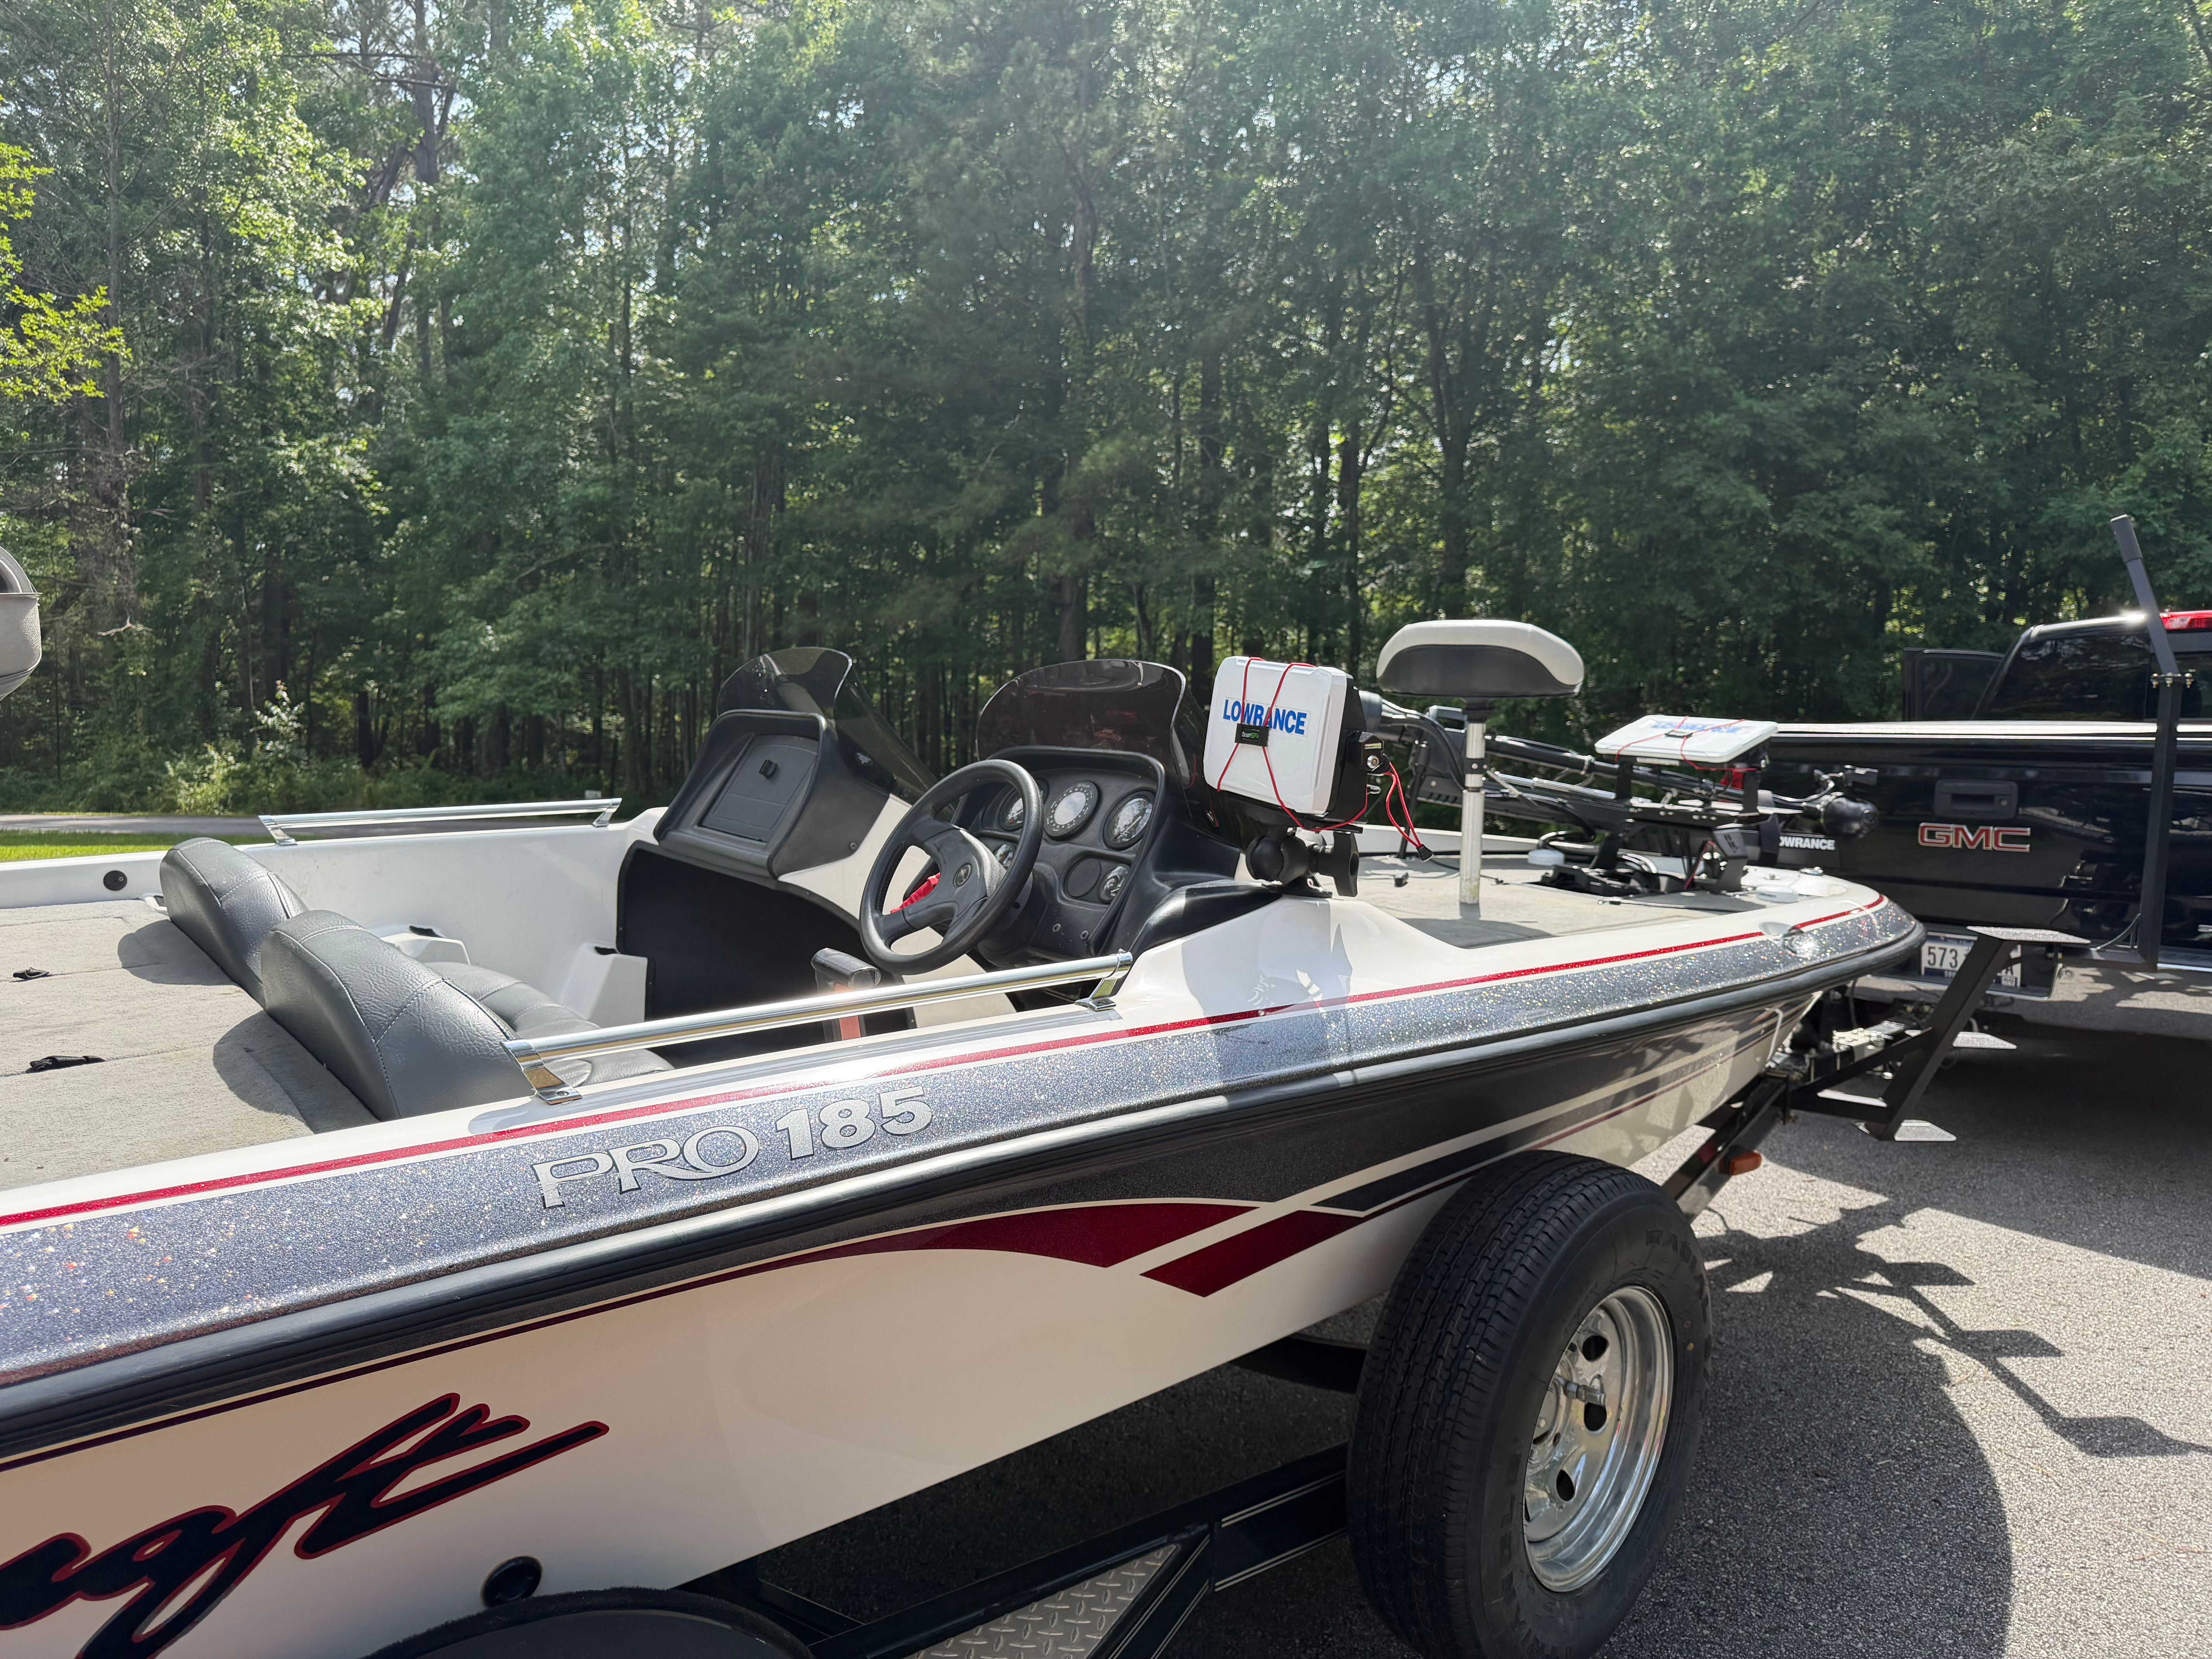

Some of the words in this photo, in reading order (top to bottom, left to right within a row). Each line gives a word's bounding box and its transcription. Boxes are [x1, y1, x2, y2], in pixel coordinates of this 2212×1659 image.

[1223, 699, 1307, 735] LOWRANCE
[1918, 822, 2031, 853] GMC
[1927, 946, 1958, 968] 573
[531, 1125, 760, 1209] PRO
[775, 1086, 933, 1160] 185
